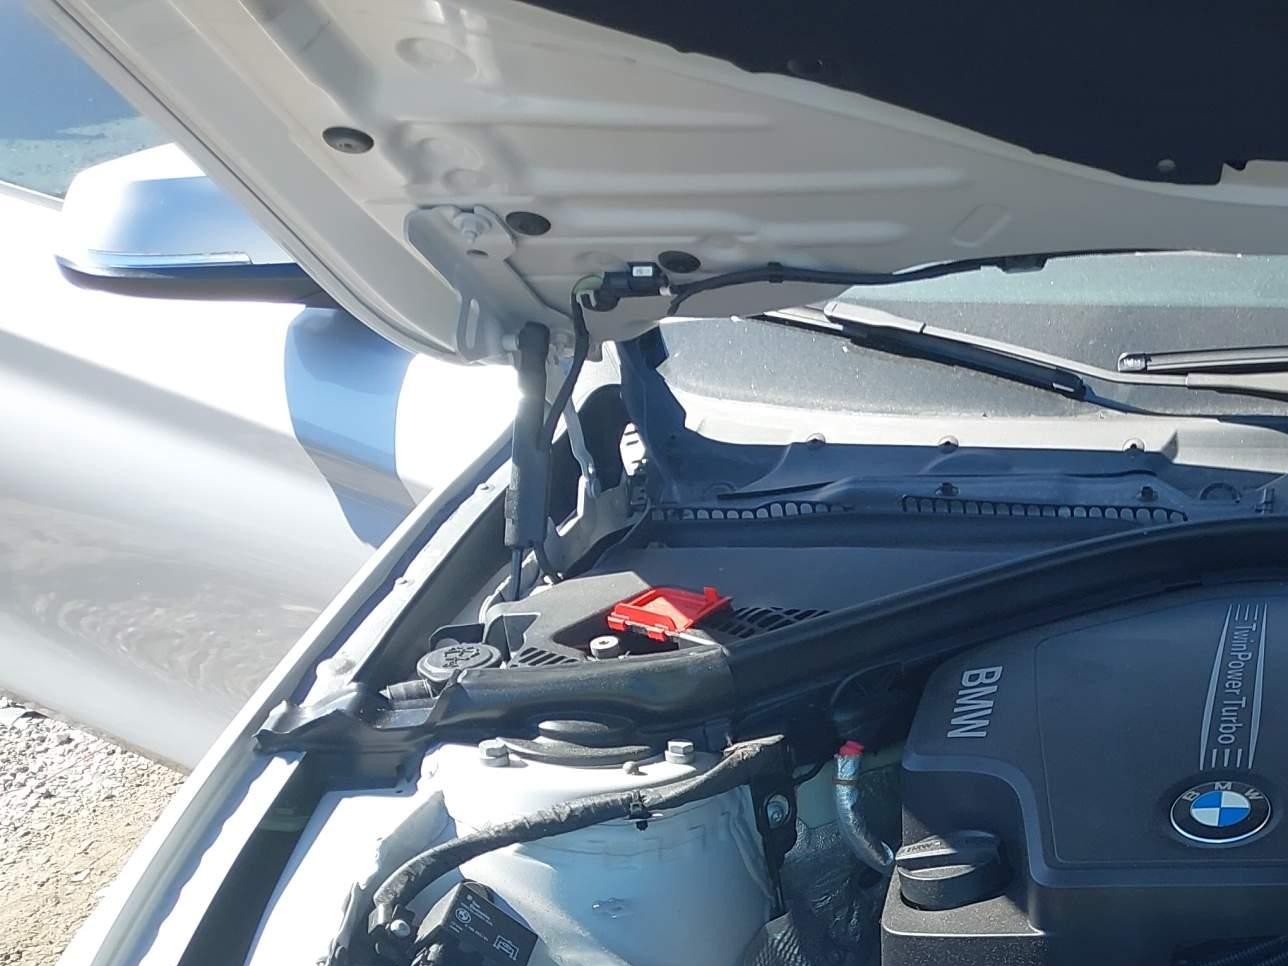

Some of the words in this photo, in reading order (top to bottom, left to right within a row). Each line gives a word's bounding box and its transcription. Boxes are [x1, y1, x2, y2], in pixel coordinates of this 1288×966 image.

[1224, 624, 1257, 697] TwinPower
[947, 665, 1003, 738] BMW
[1217, 696, 1247, 745] Turbo
[1183, 782, 1262, 801] BMW
